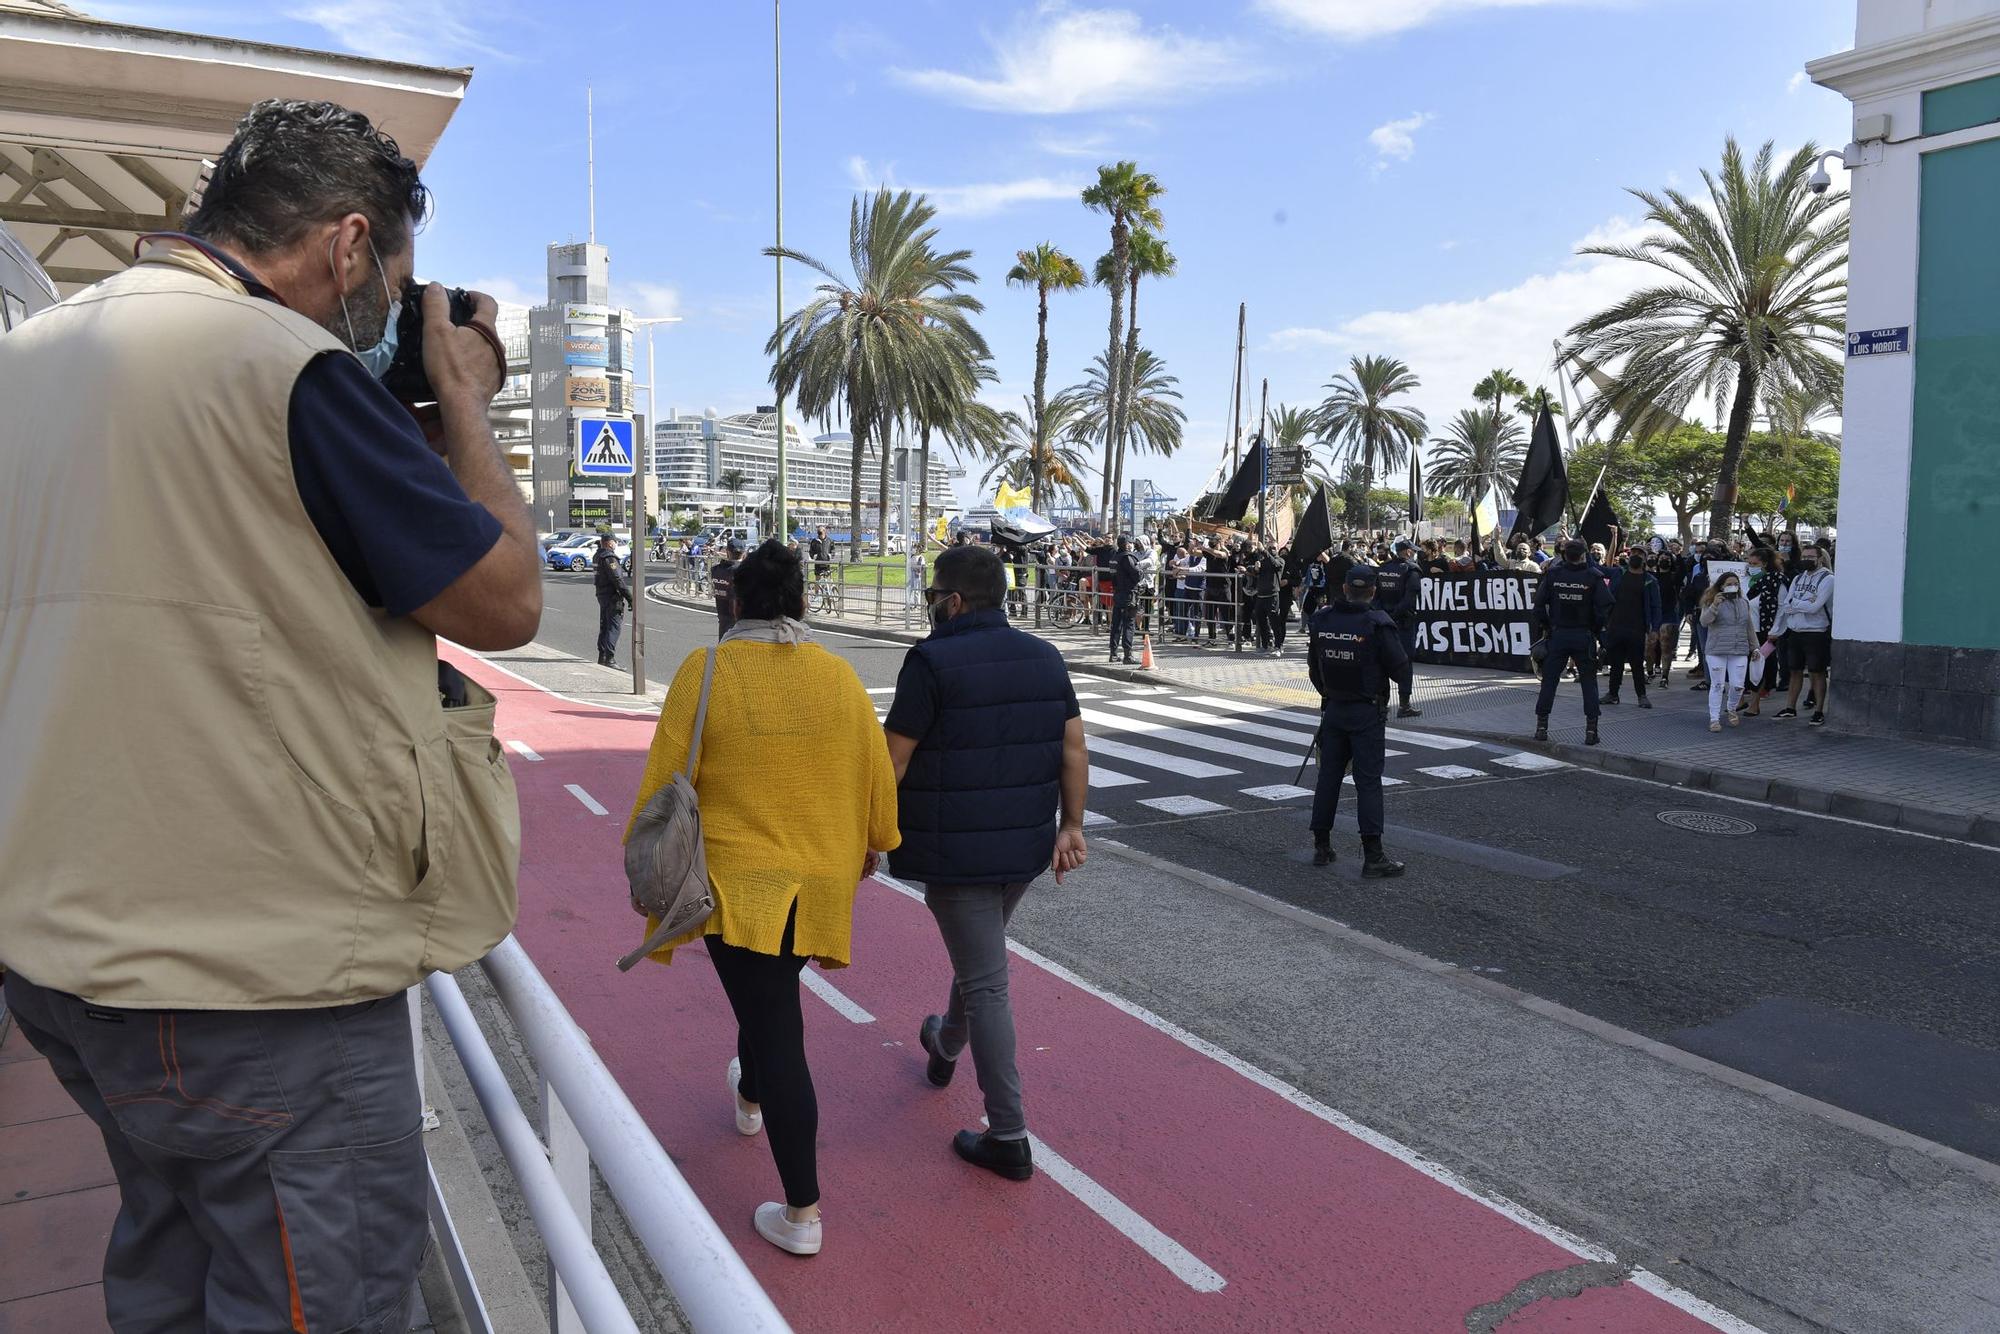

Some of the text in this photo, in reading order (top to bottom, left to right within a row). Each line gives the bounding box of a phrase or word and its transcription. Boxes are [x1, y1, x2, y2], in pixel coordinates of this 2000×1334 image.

[1872, 329, 1897, 338] CALLE
[1853, 341, 1901, 355] LUIS MOROTE
[1553, 581, 1585, 589] POLICIA
[1416, 578, 1469, 610] RIAS
[1318, 631, 1358, 641] POLICIA
